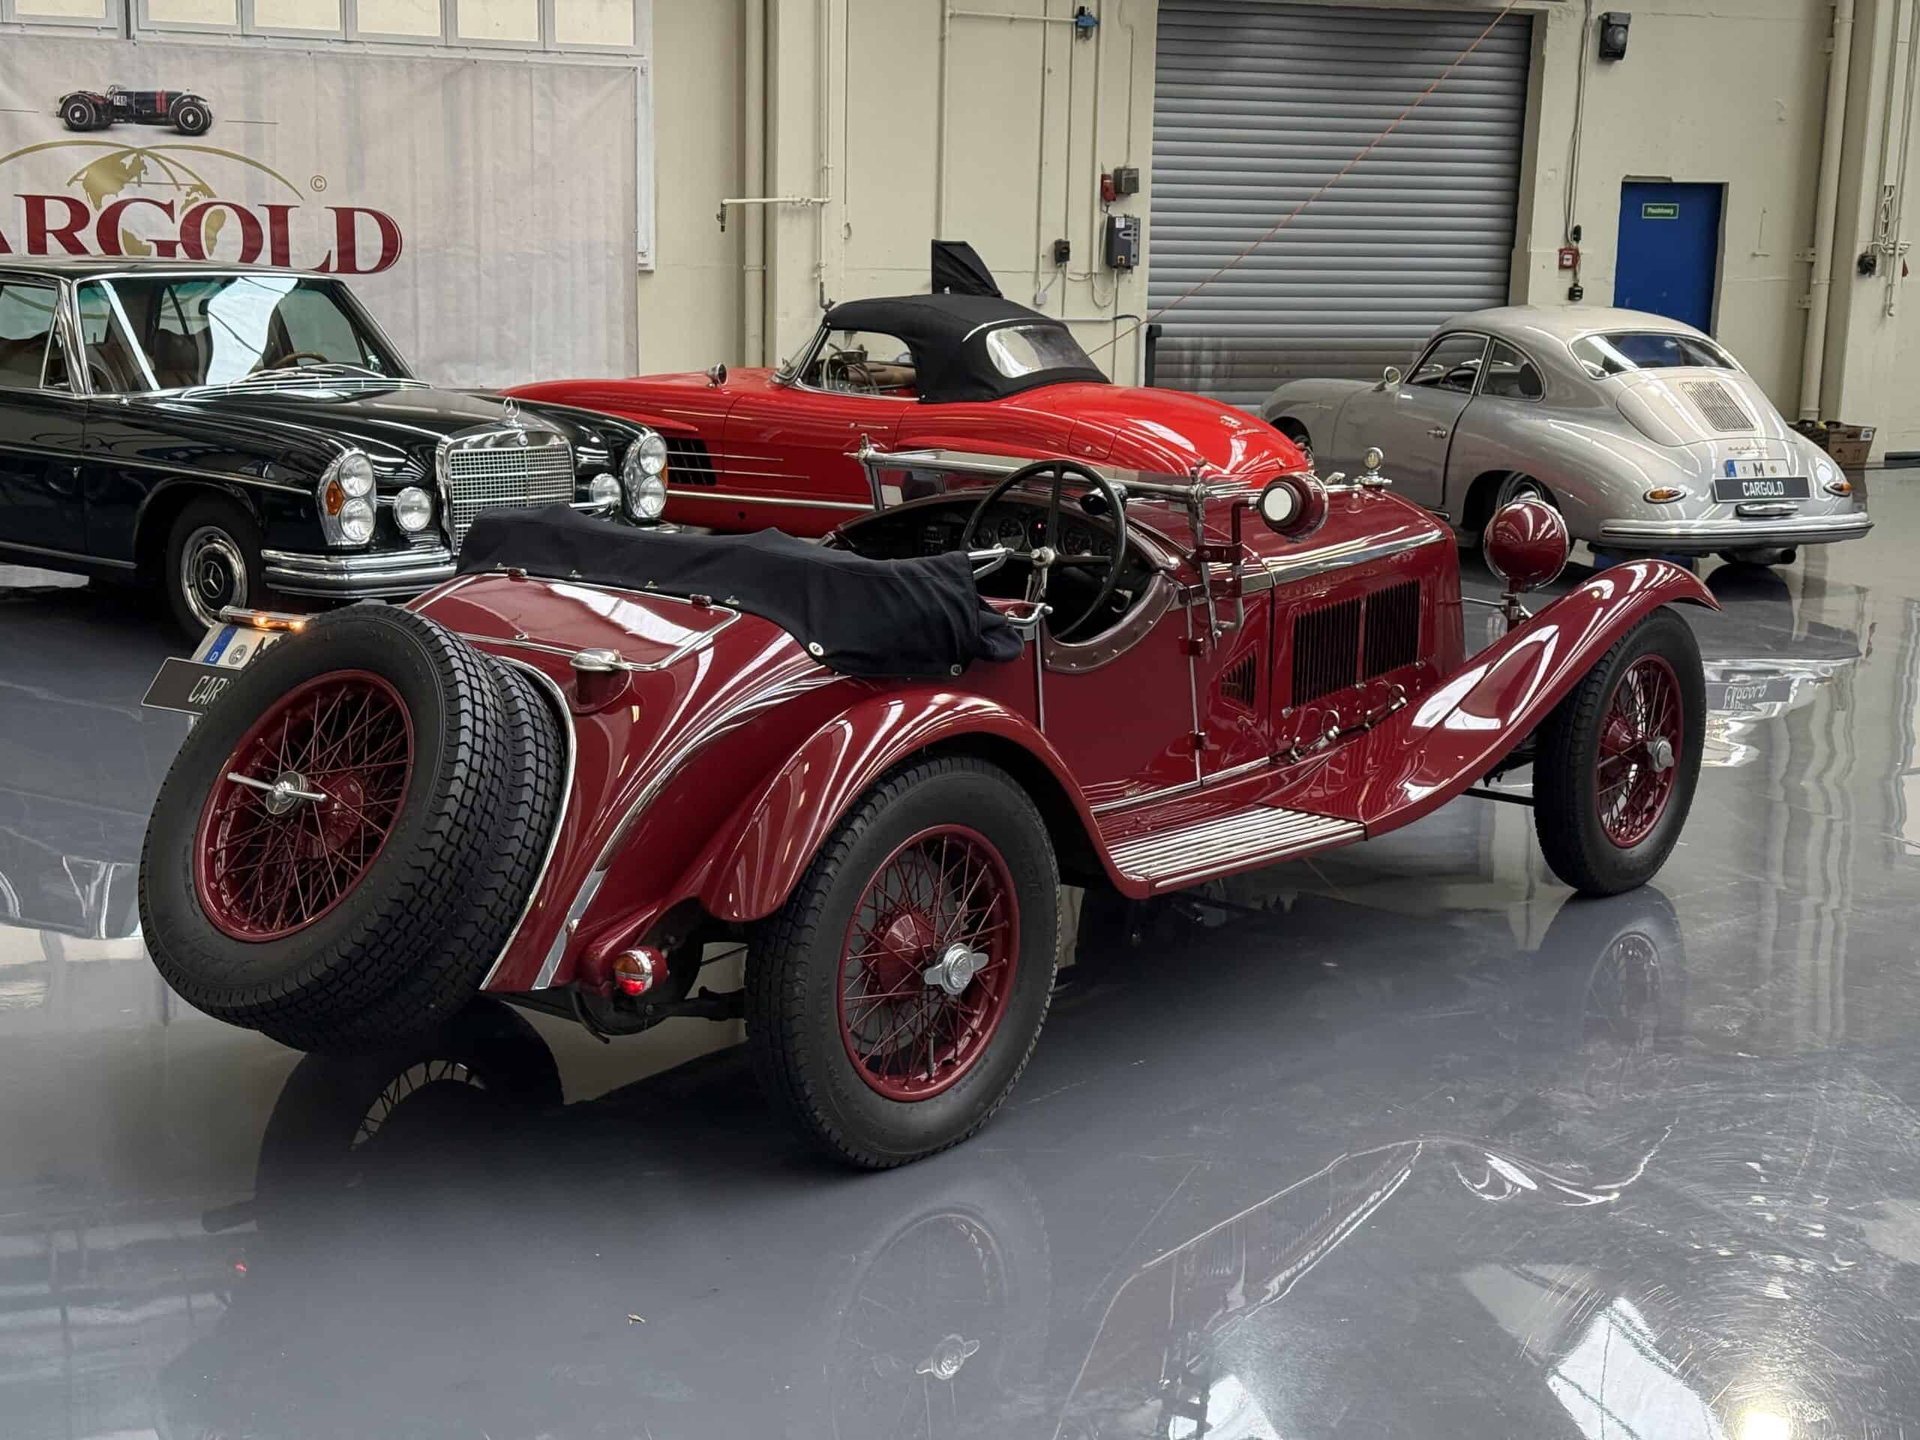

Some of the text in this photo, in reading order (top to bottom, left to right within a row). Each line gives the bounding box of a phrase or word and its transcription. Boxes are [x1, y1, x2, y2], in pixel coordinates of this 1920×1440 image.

[0, 194, 403, 275] RGOLD
[1742, 481, 1784, 497] CARGOLD
[209, 651, 218, 662] D
[187, 675, 230, 705] CAR
